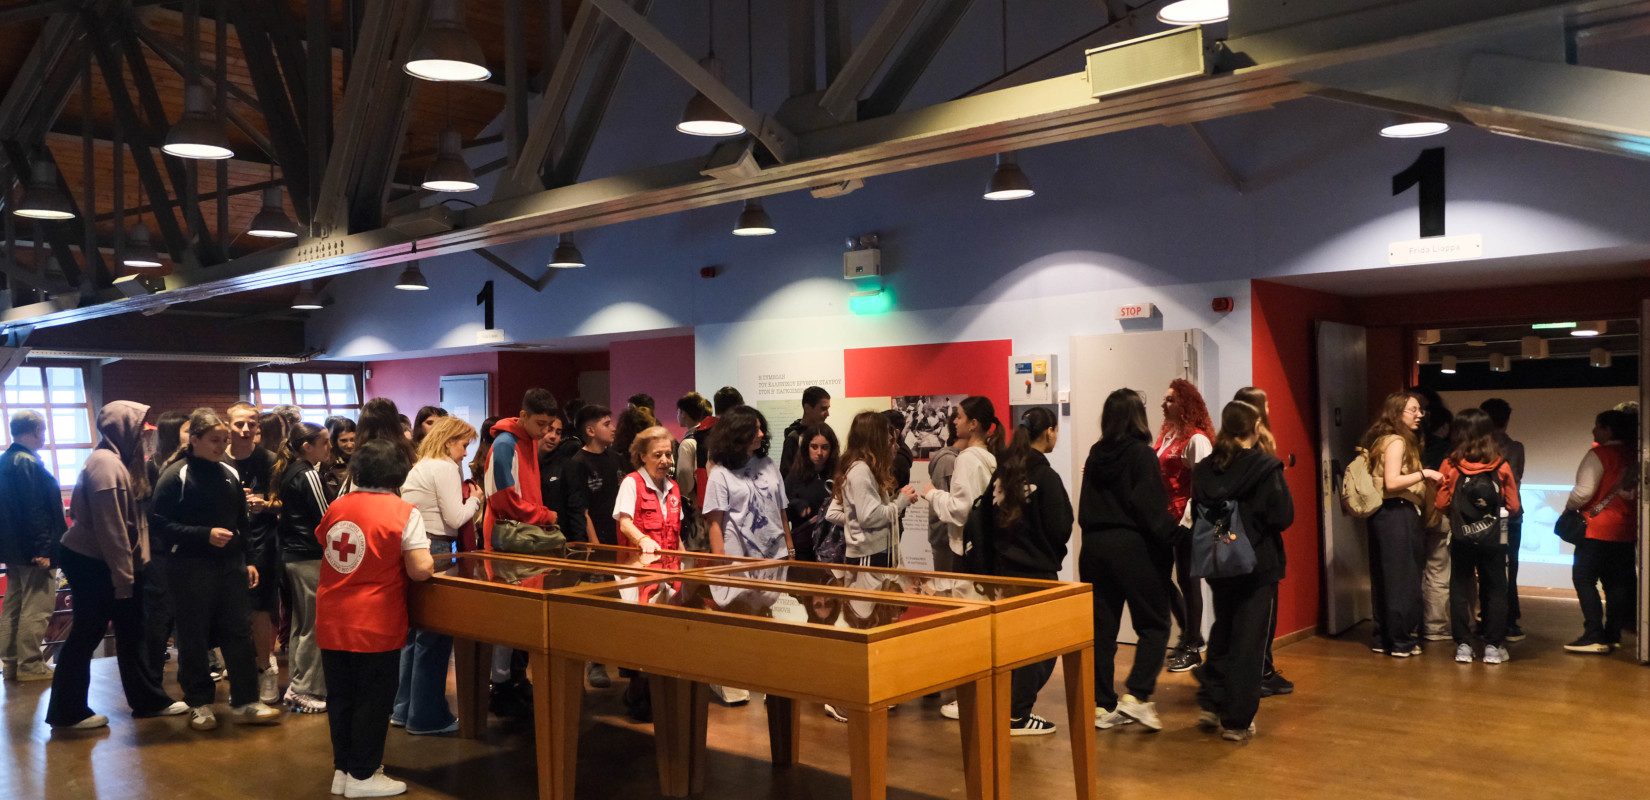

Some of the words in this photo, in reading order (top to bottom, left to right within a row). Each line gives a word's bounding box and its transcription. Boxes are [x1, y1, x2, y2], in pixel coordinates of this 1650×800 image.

[1392, 147, 1446, 238] 1
[476, 280, 495, 330] 1
[1121, 306, 1142, 316] STOP
